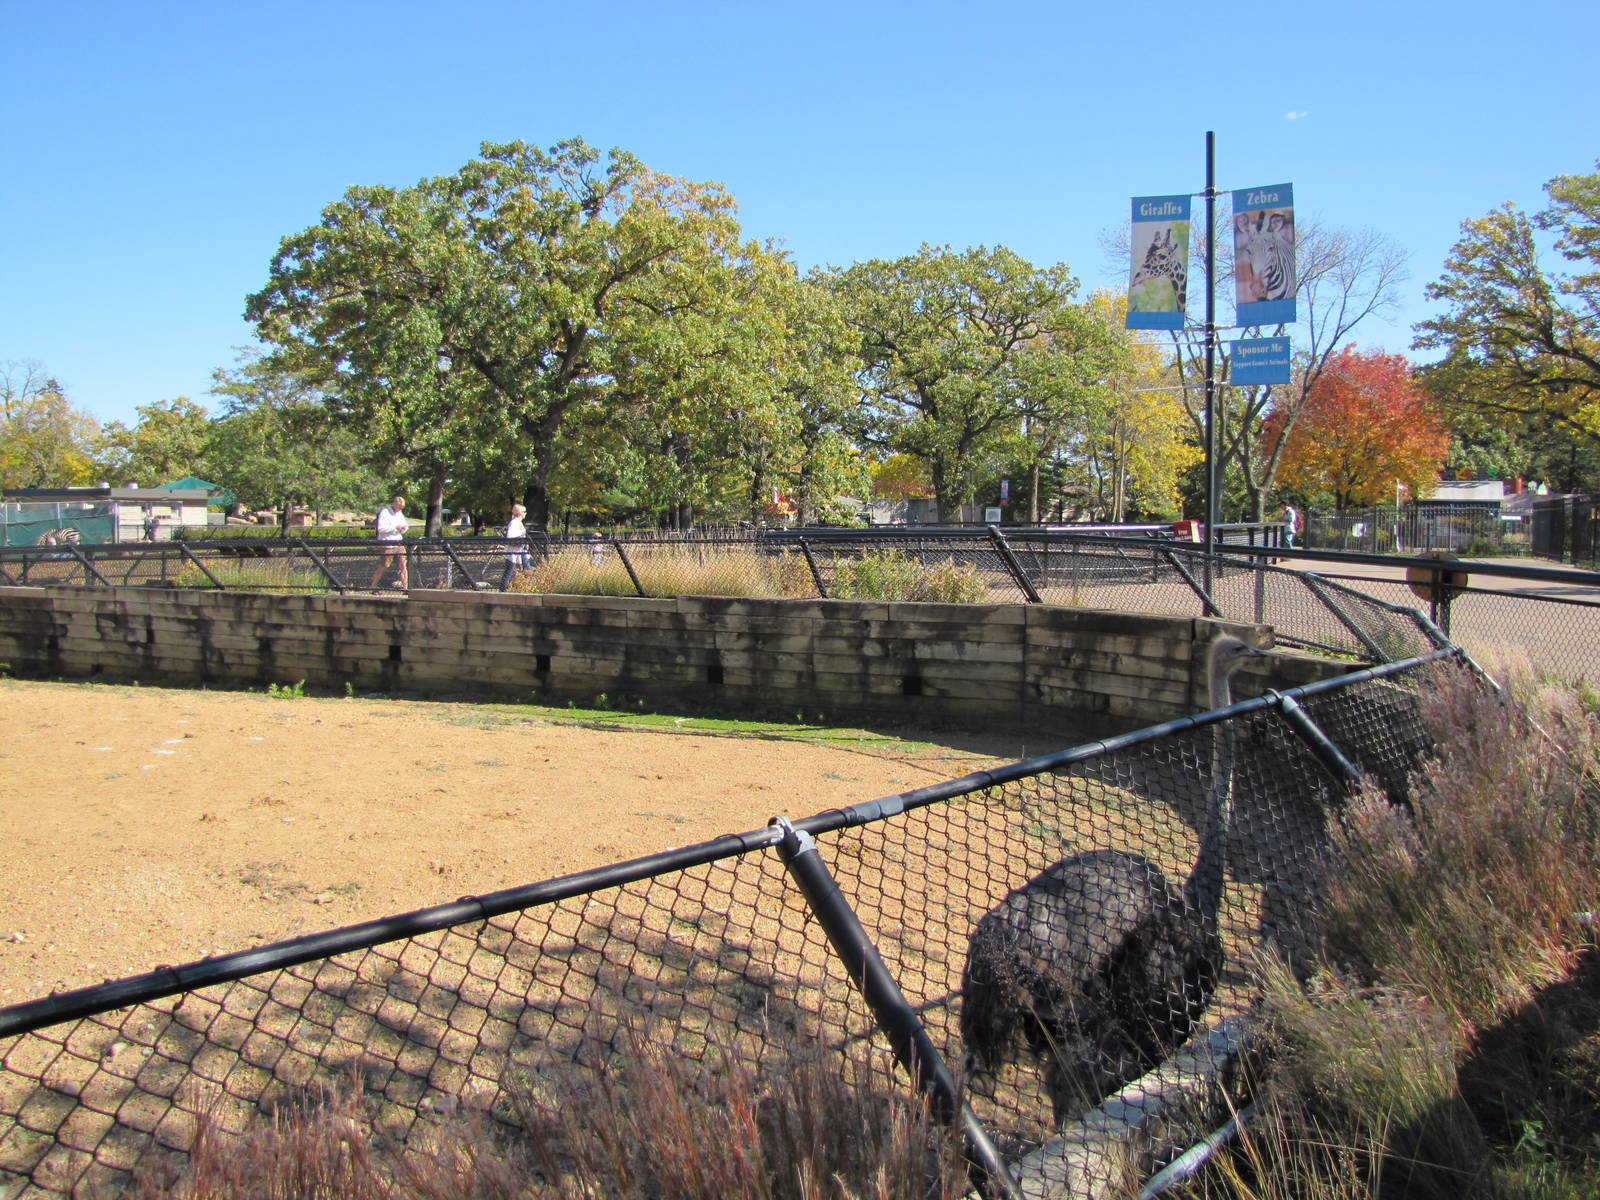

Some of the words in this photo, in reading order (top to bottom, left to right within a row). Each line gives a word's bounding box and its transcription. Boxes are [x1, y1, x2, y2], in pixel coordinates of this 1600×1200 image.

[1247, 191, 1279, 205] Zebra
[1140, 202, 1182, 216] Giraffes
[1238, 345, 1269, 358] Sponsor
[1271, 343, 1283, 353] Me
